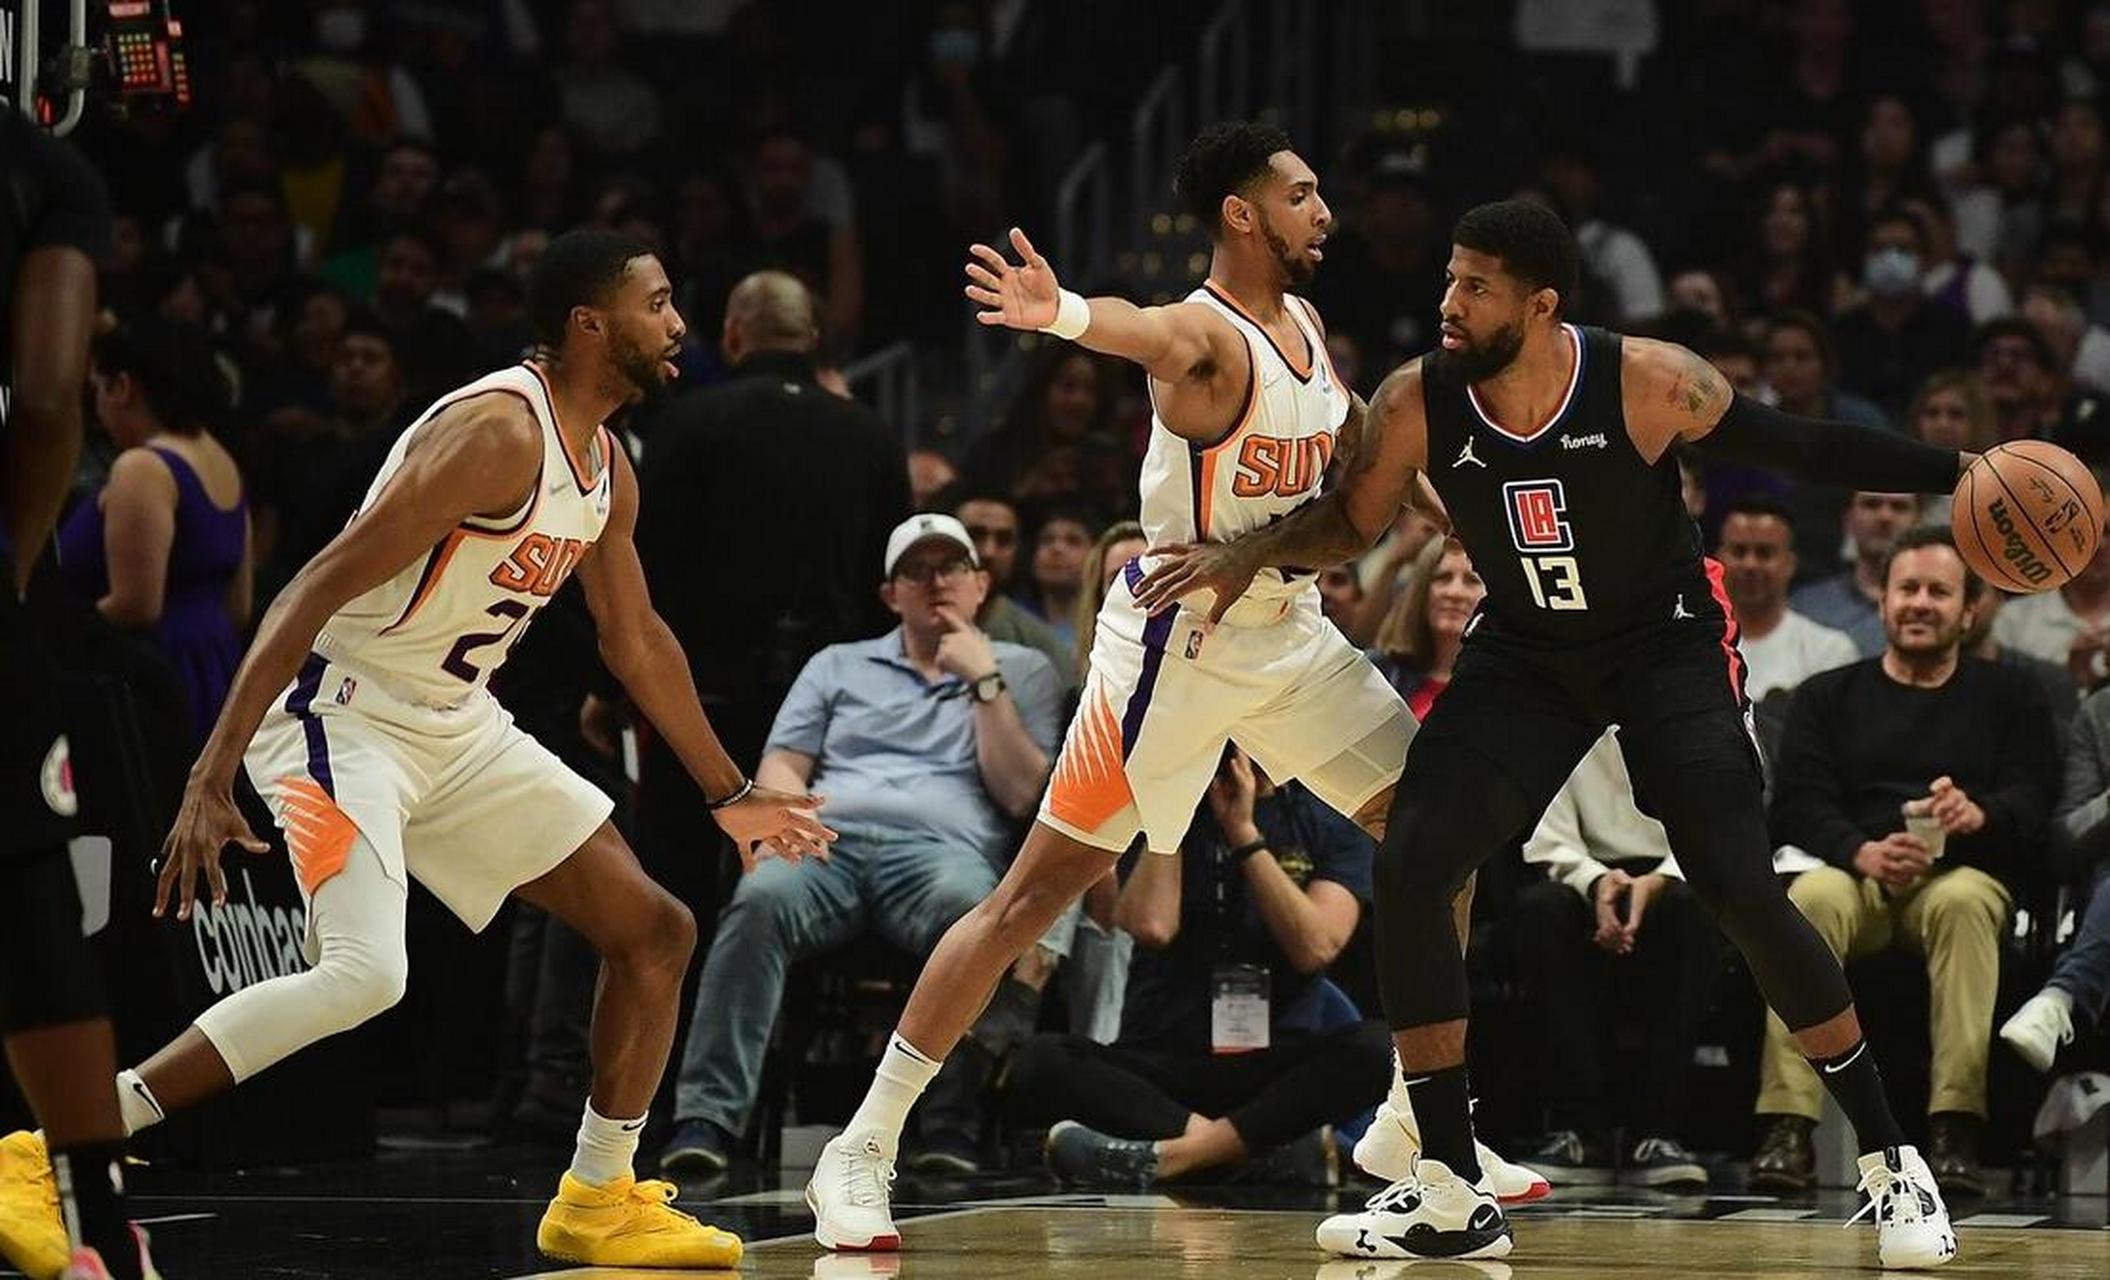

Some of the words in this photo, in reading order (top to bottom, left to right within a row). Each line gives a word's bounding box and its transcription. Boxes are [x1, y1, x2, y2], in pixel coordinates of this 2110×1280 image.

[1560, 433, 1608, 450] honey
[1988, 497, 2053, 585] Wilson
[1520, 556, 1589, 611] 13
